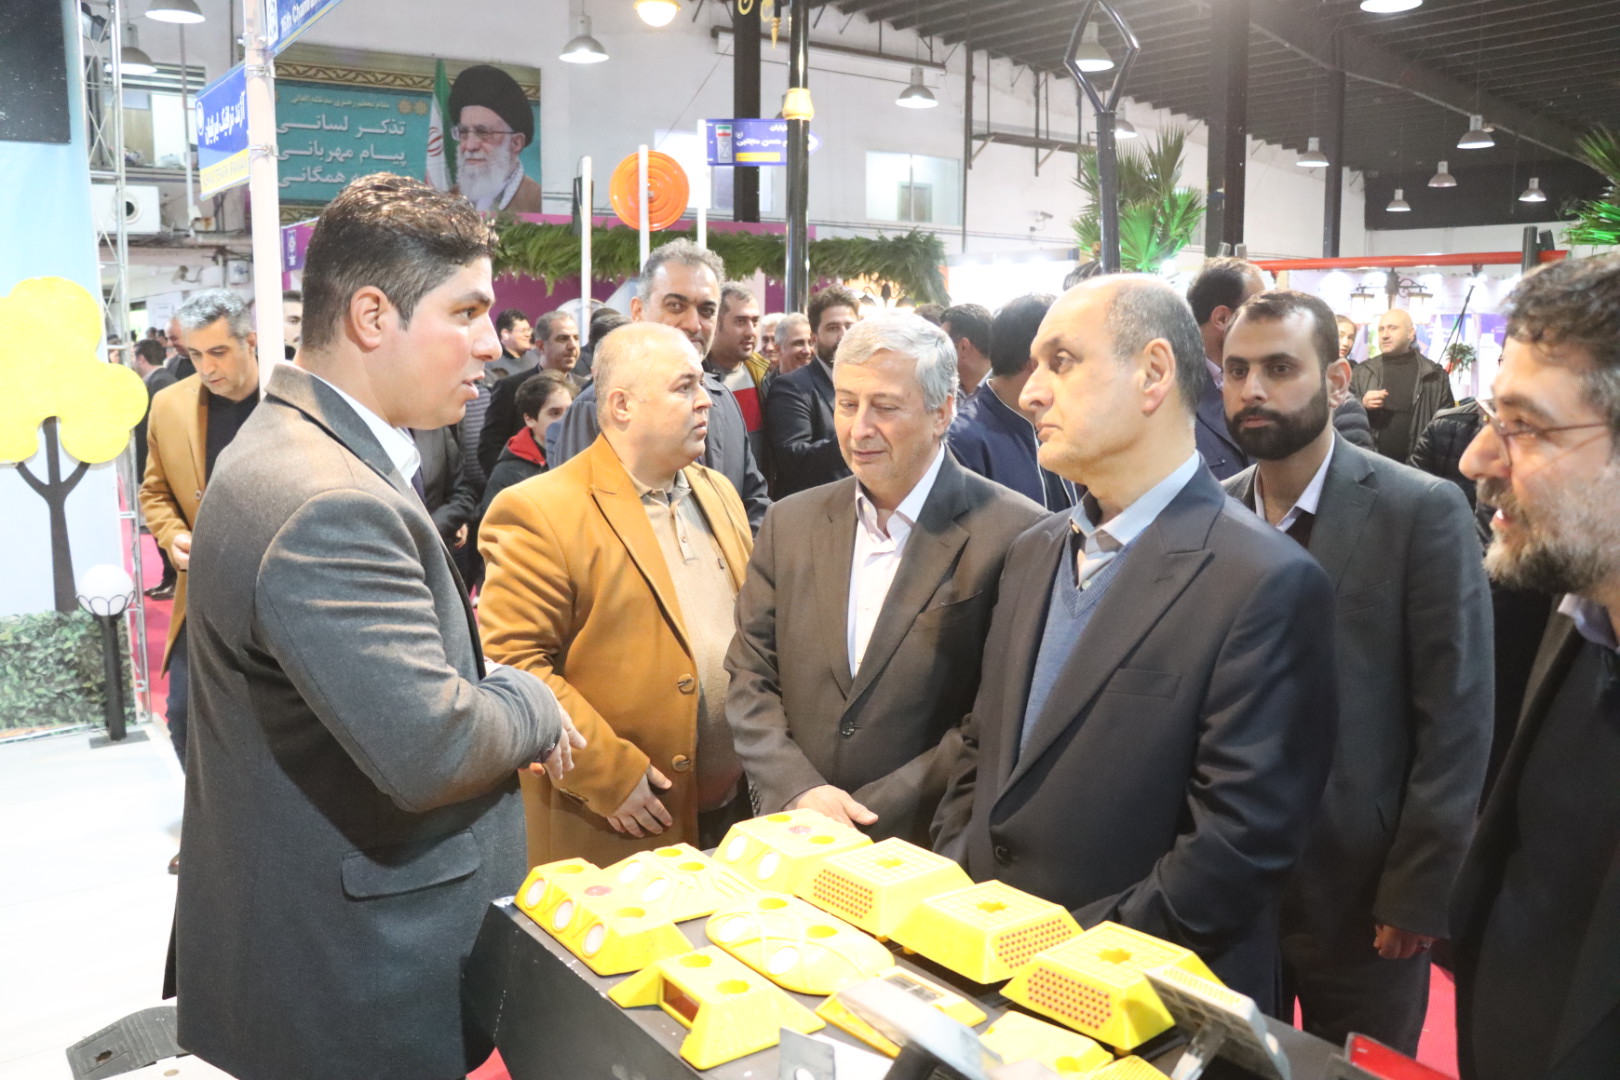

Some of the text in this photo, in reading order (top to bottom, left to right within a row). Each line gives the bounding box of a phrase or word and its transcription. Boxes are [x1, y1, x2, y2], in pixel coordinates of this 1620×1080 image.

[276, 114, 406, 138] تذکر لسانی
[278, 141, 407, 166] پیام مهربانی
[278, 167, 346, 188] همگانی
